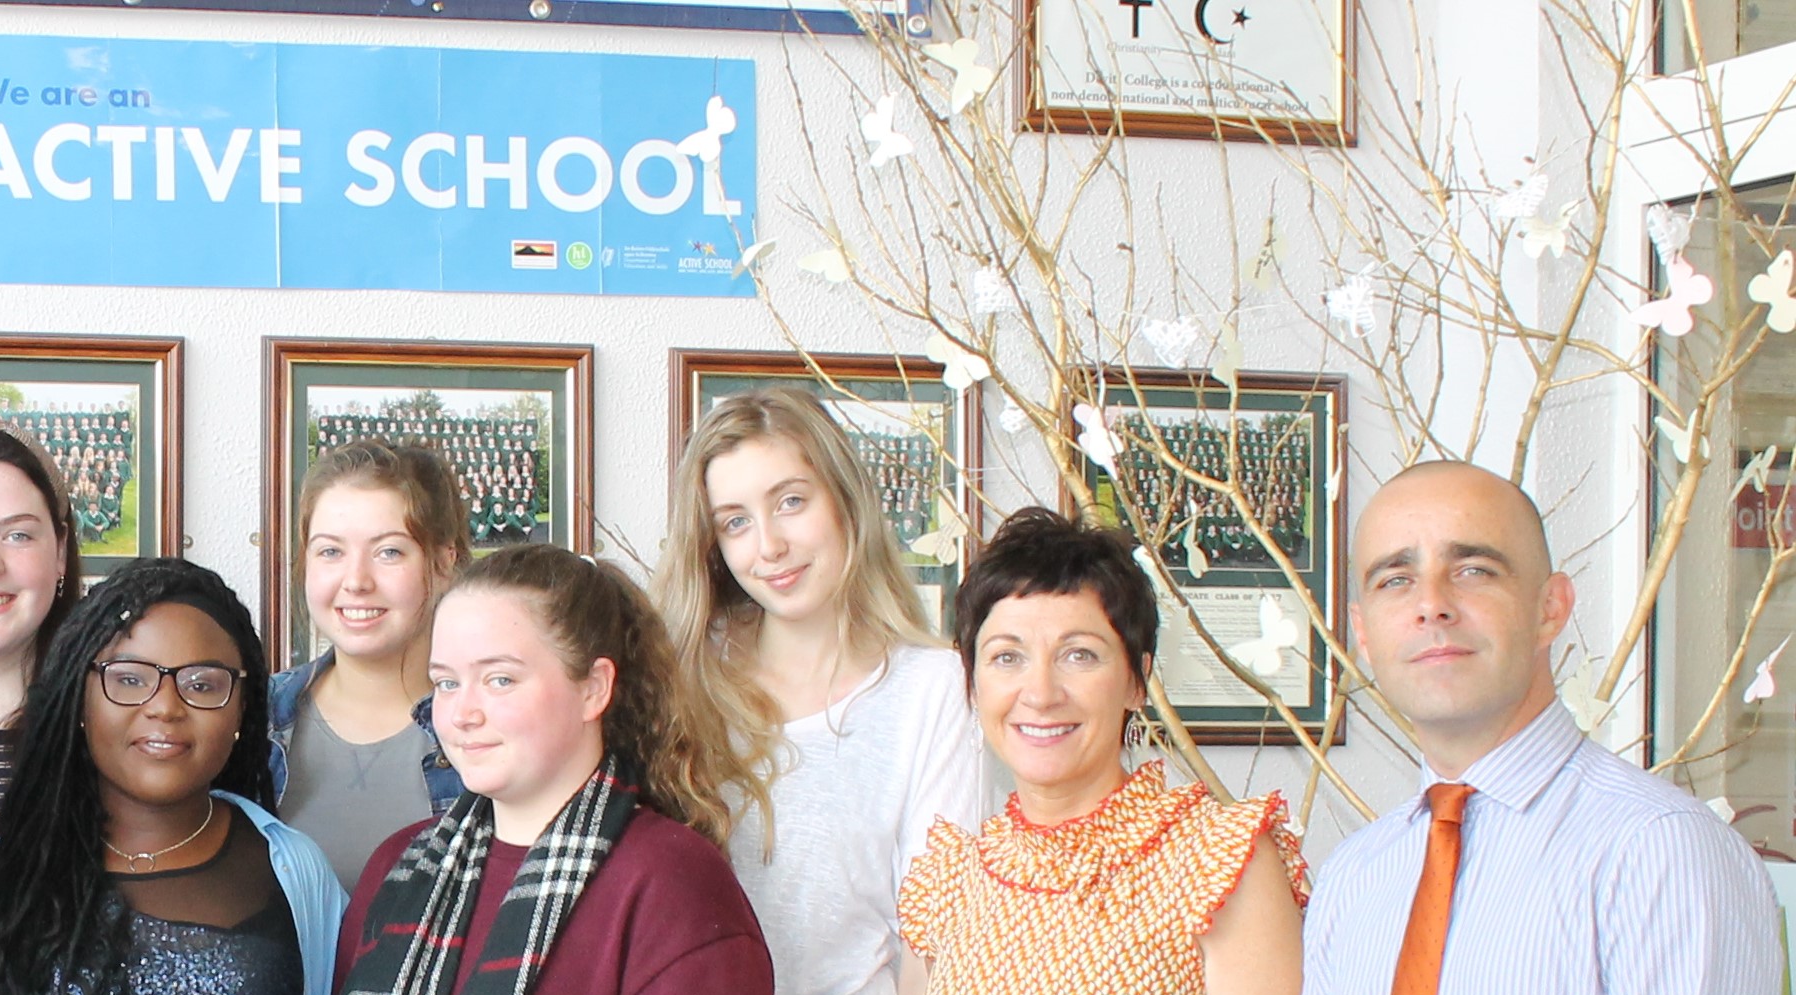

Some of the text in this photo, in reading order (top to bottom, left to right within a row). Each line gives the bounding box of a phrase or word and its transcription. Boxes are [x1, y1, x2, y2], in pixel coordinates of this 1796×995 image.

[1124, 74, 1168, 89] College
[1170, 77, 1179, 88] is
[40, 87, 98, 107] are
[108, 88, 151, 108] an
[344, 129, 742, 216] SCHOOL
[678, 257, 702, 269] ACTIVE
[705, 257, 733, 269] SCHOOL
